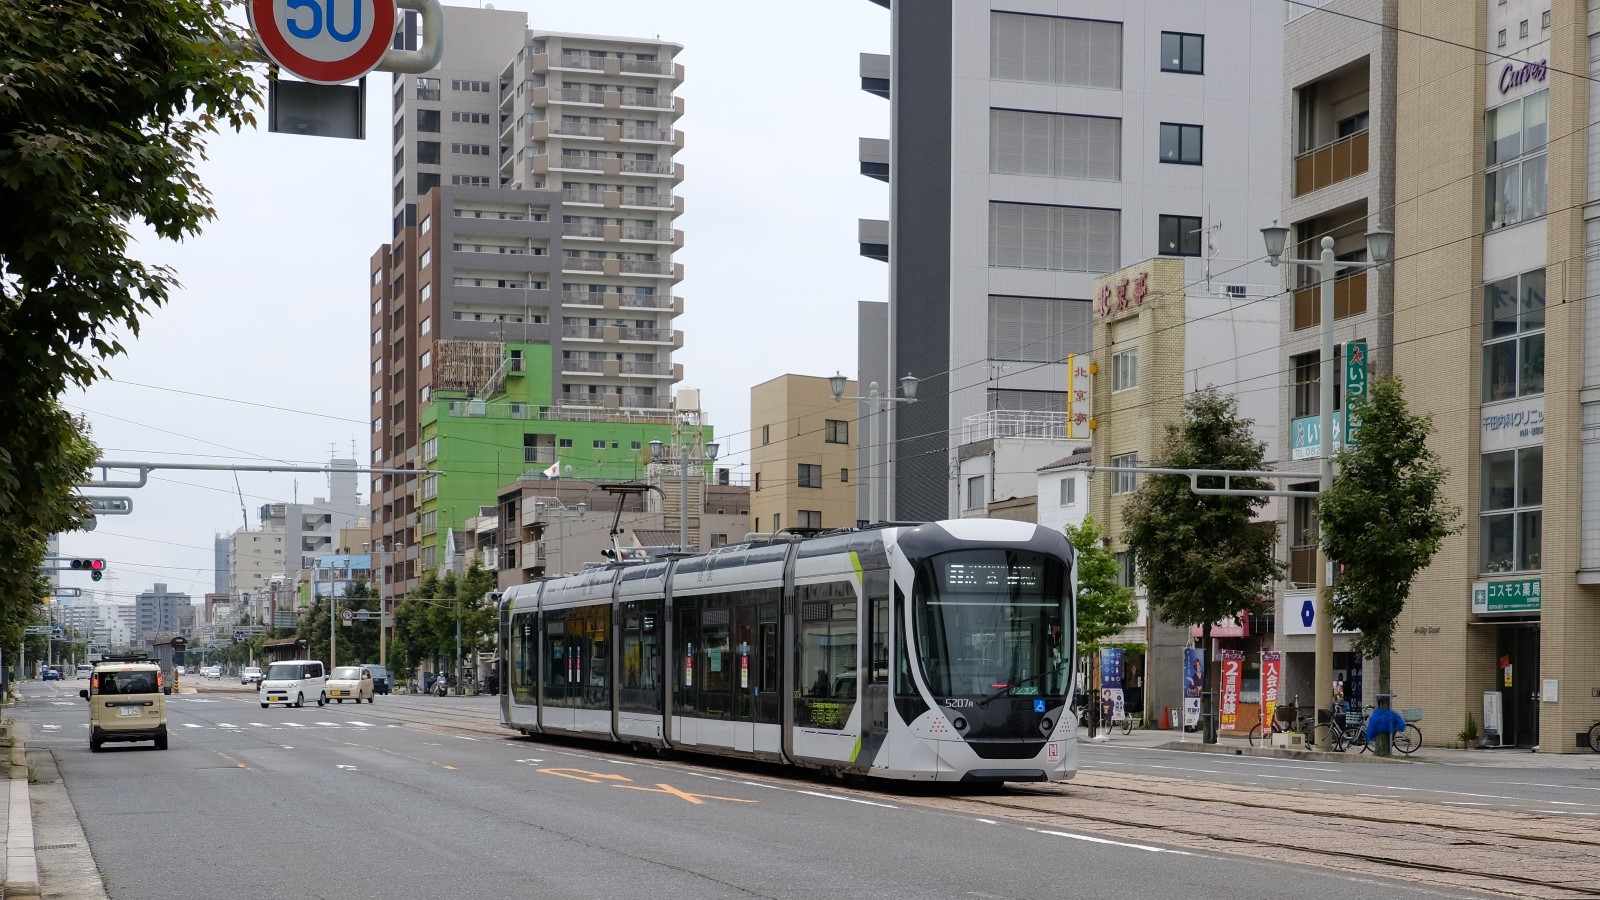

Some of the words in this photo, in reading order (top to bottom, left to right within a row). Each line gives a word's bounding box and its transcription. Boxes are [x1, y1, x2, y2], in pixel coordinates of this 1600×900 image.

[286, 0, 362, 43] 50
[1498, 58, 1547, 94] Curves
[1097, 272, 1149, 317] 北京亭
[1073, 366, 1088, 426] 北京亭
[1489, 582, 1541, 597] コスモス薬局
[945, 698, 974, 708] 5207A
